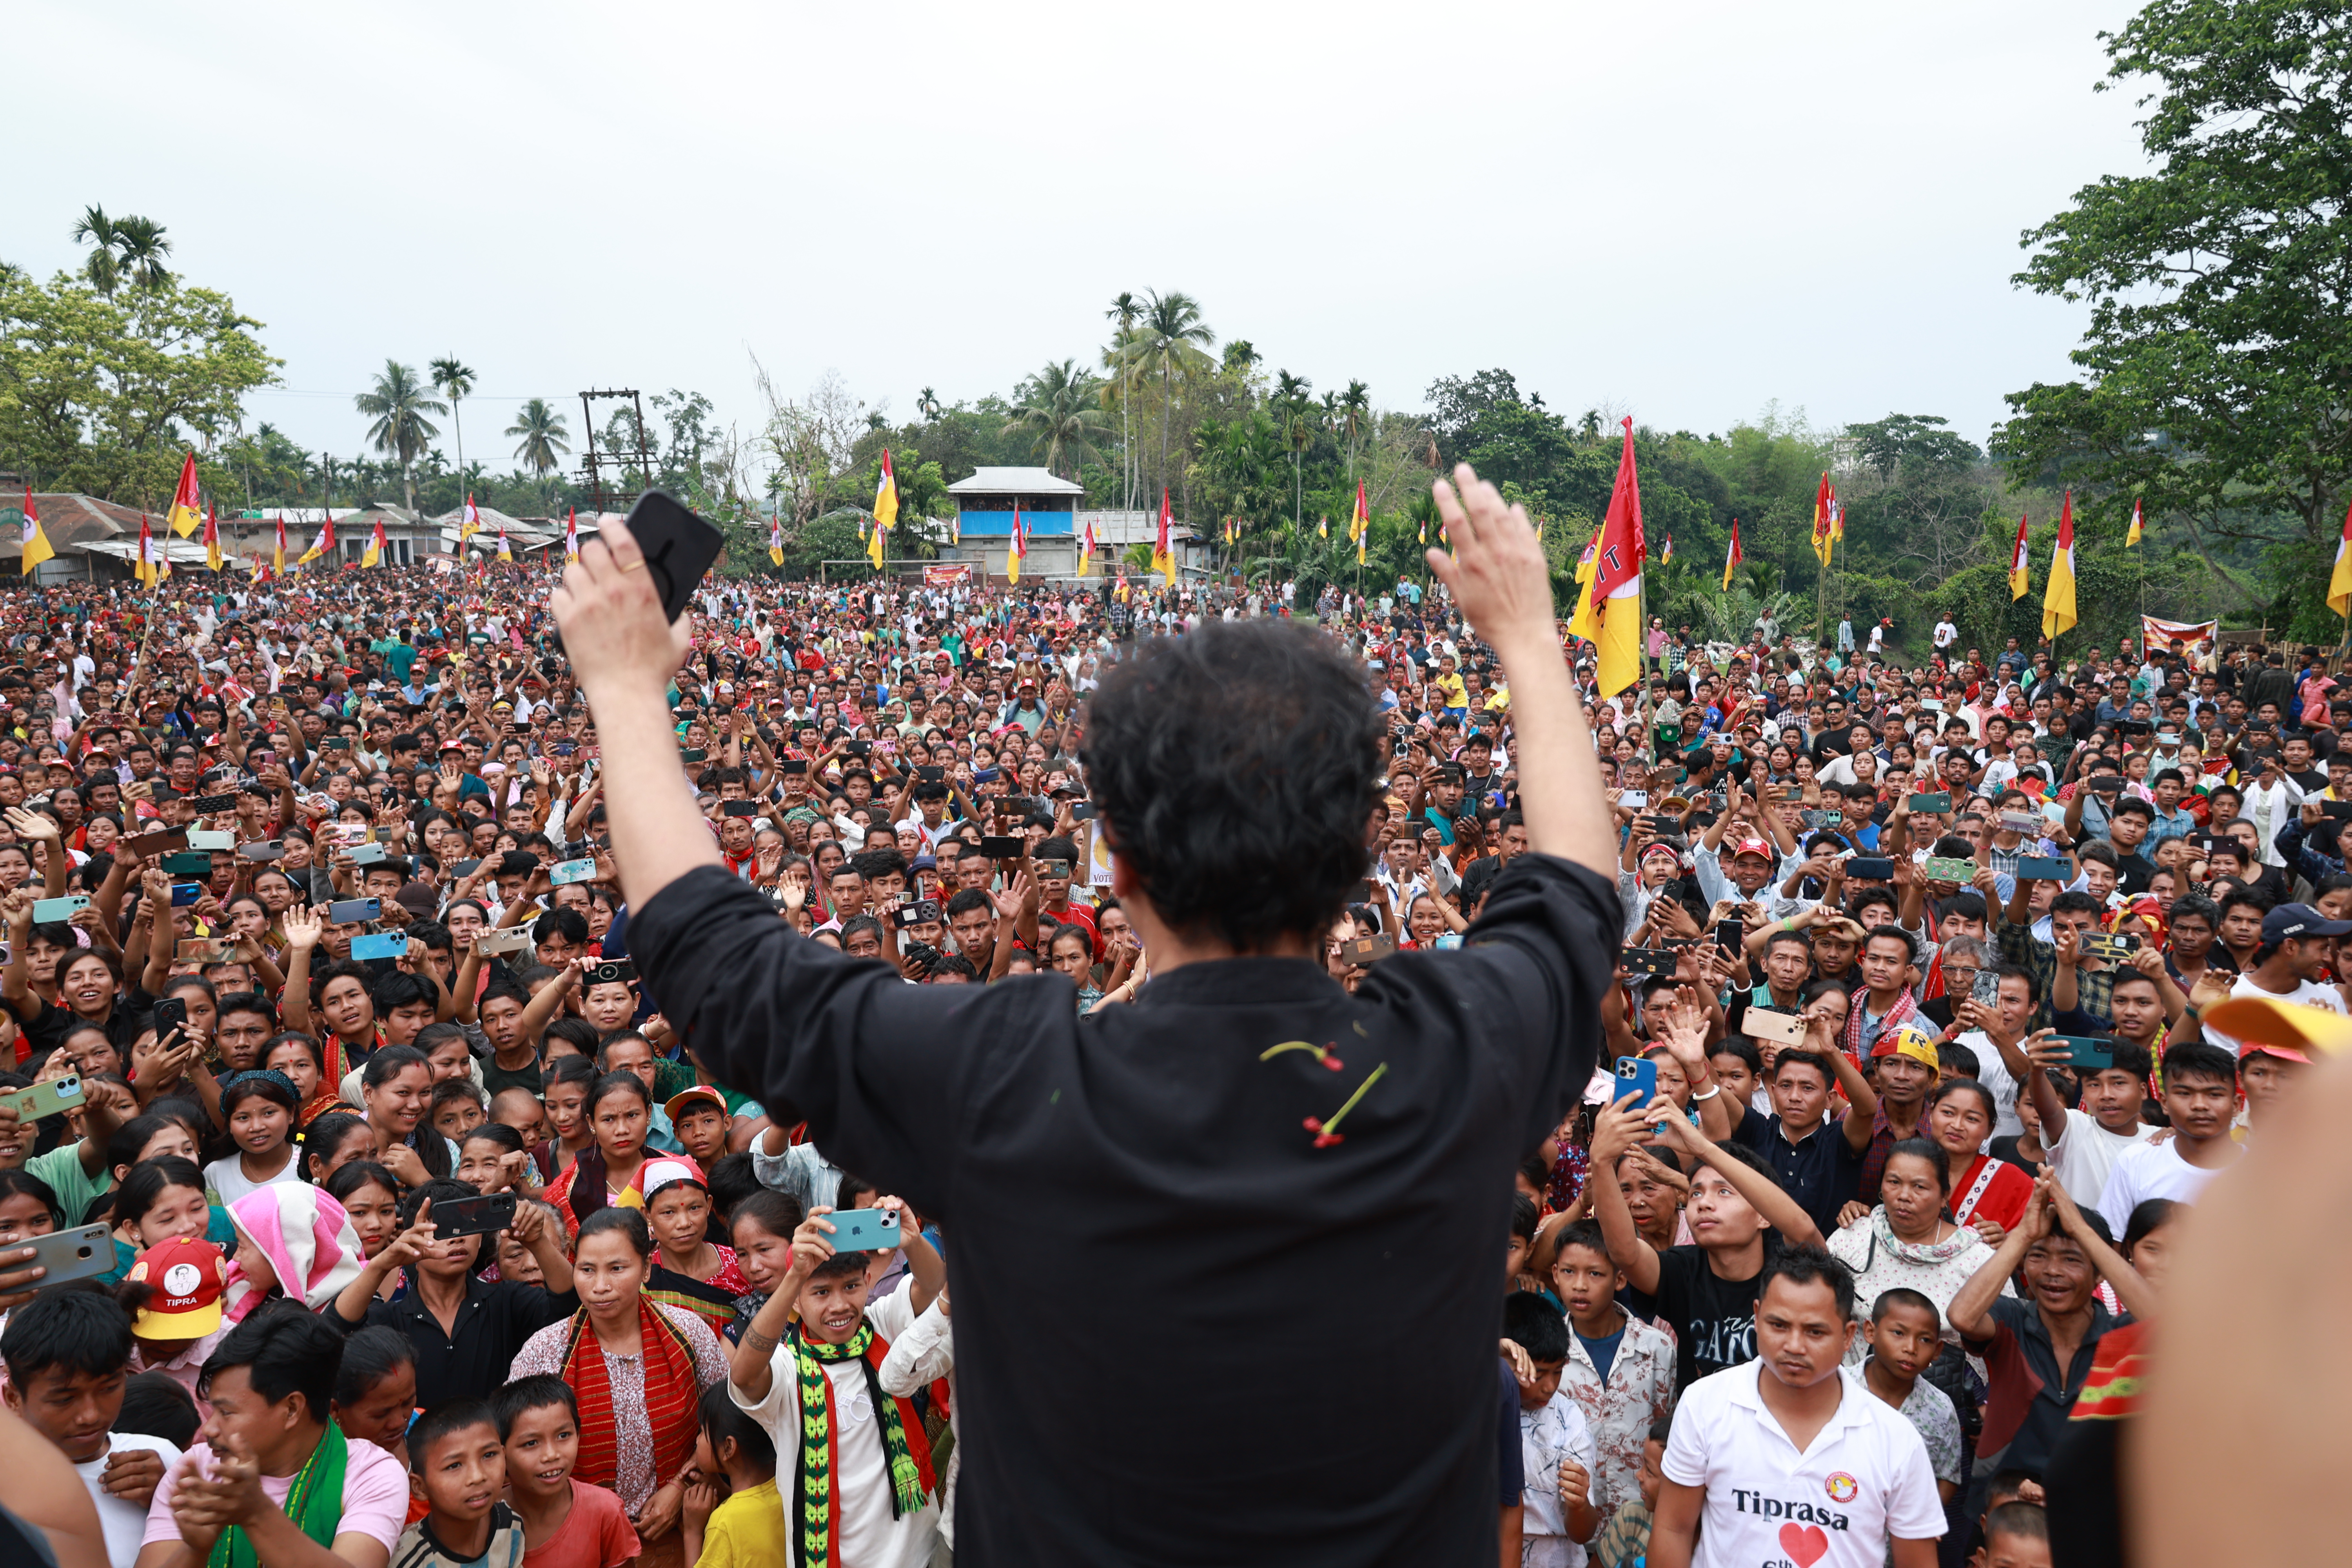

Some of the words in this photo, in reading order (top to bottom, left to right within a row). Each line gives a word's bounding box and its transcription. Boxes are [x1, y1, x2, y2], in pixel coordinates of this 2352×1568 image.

[1094, 873, 1113, 882] VOTE
[166, 1297, 197, 1307] TIPRA
[1732, 1488, 1848, 1532] Tiprasa
